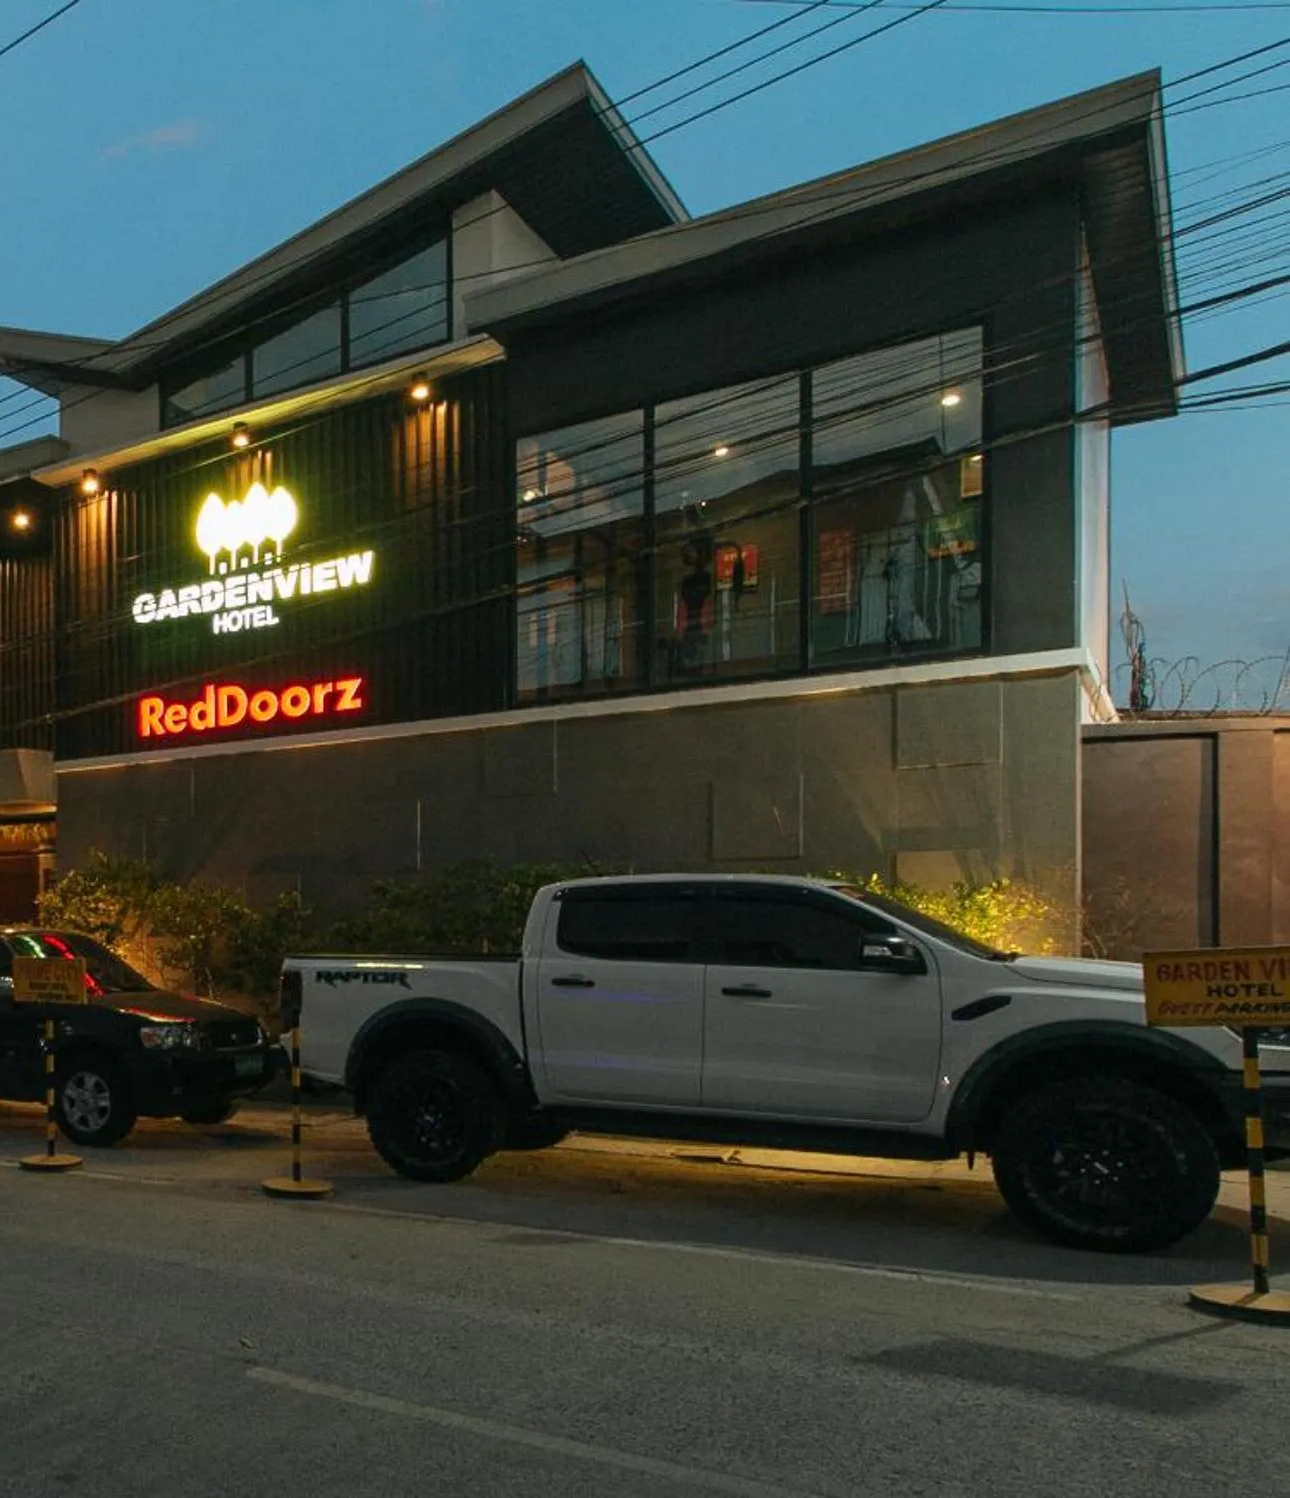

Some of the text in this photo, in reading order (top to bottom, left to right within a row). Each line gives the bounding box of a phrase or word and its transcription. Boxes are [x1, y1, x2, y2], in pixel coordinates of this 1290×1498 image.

[132, 550, 375, 623] GARDENVIEW
[212, 605, 280, 634] HOTEL
[139, 678, 362, 737] RedDoorz
[315, 970, 413, 990] RAPTOR
[1156, 957, 1290, 983] GARDEN VI
[1206, 982, 1283, 998] HOTEL
